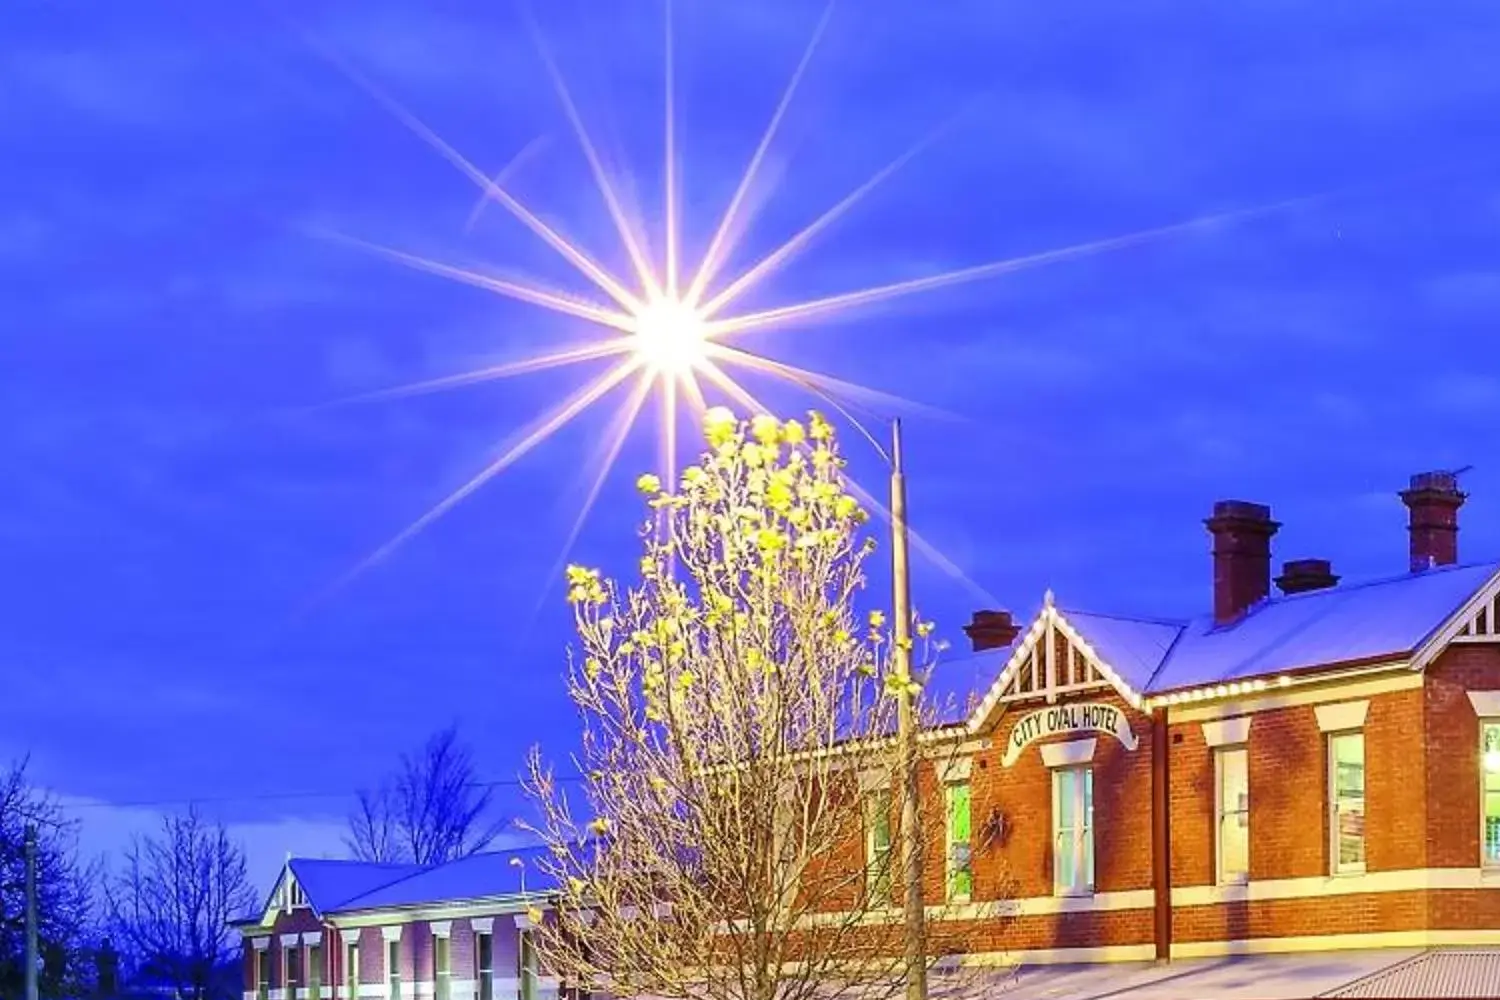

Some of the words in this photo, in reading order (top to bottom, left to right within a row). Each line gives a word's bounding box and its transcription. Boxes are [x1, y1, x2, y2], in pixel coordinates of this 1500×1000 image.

[1013, 711, 1042, 747] CITY
[1047, 707, 1079, 731] OVAL
[1083, 704, 1118, 733] HOTEL
